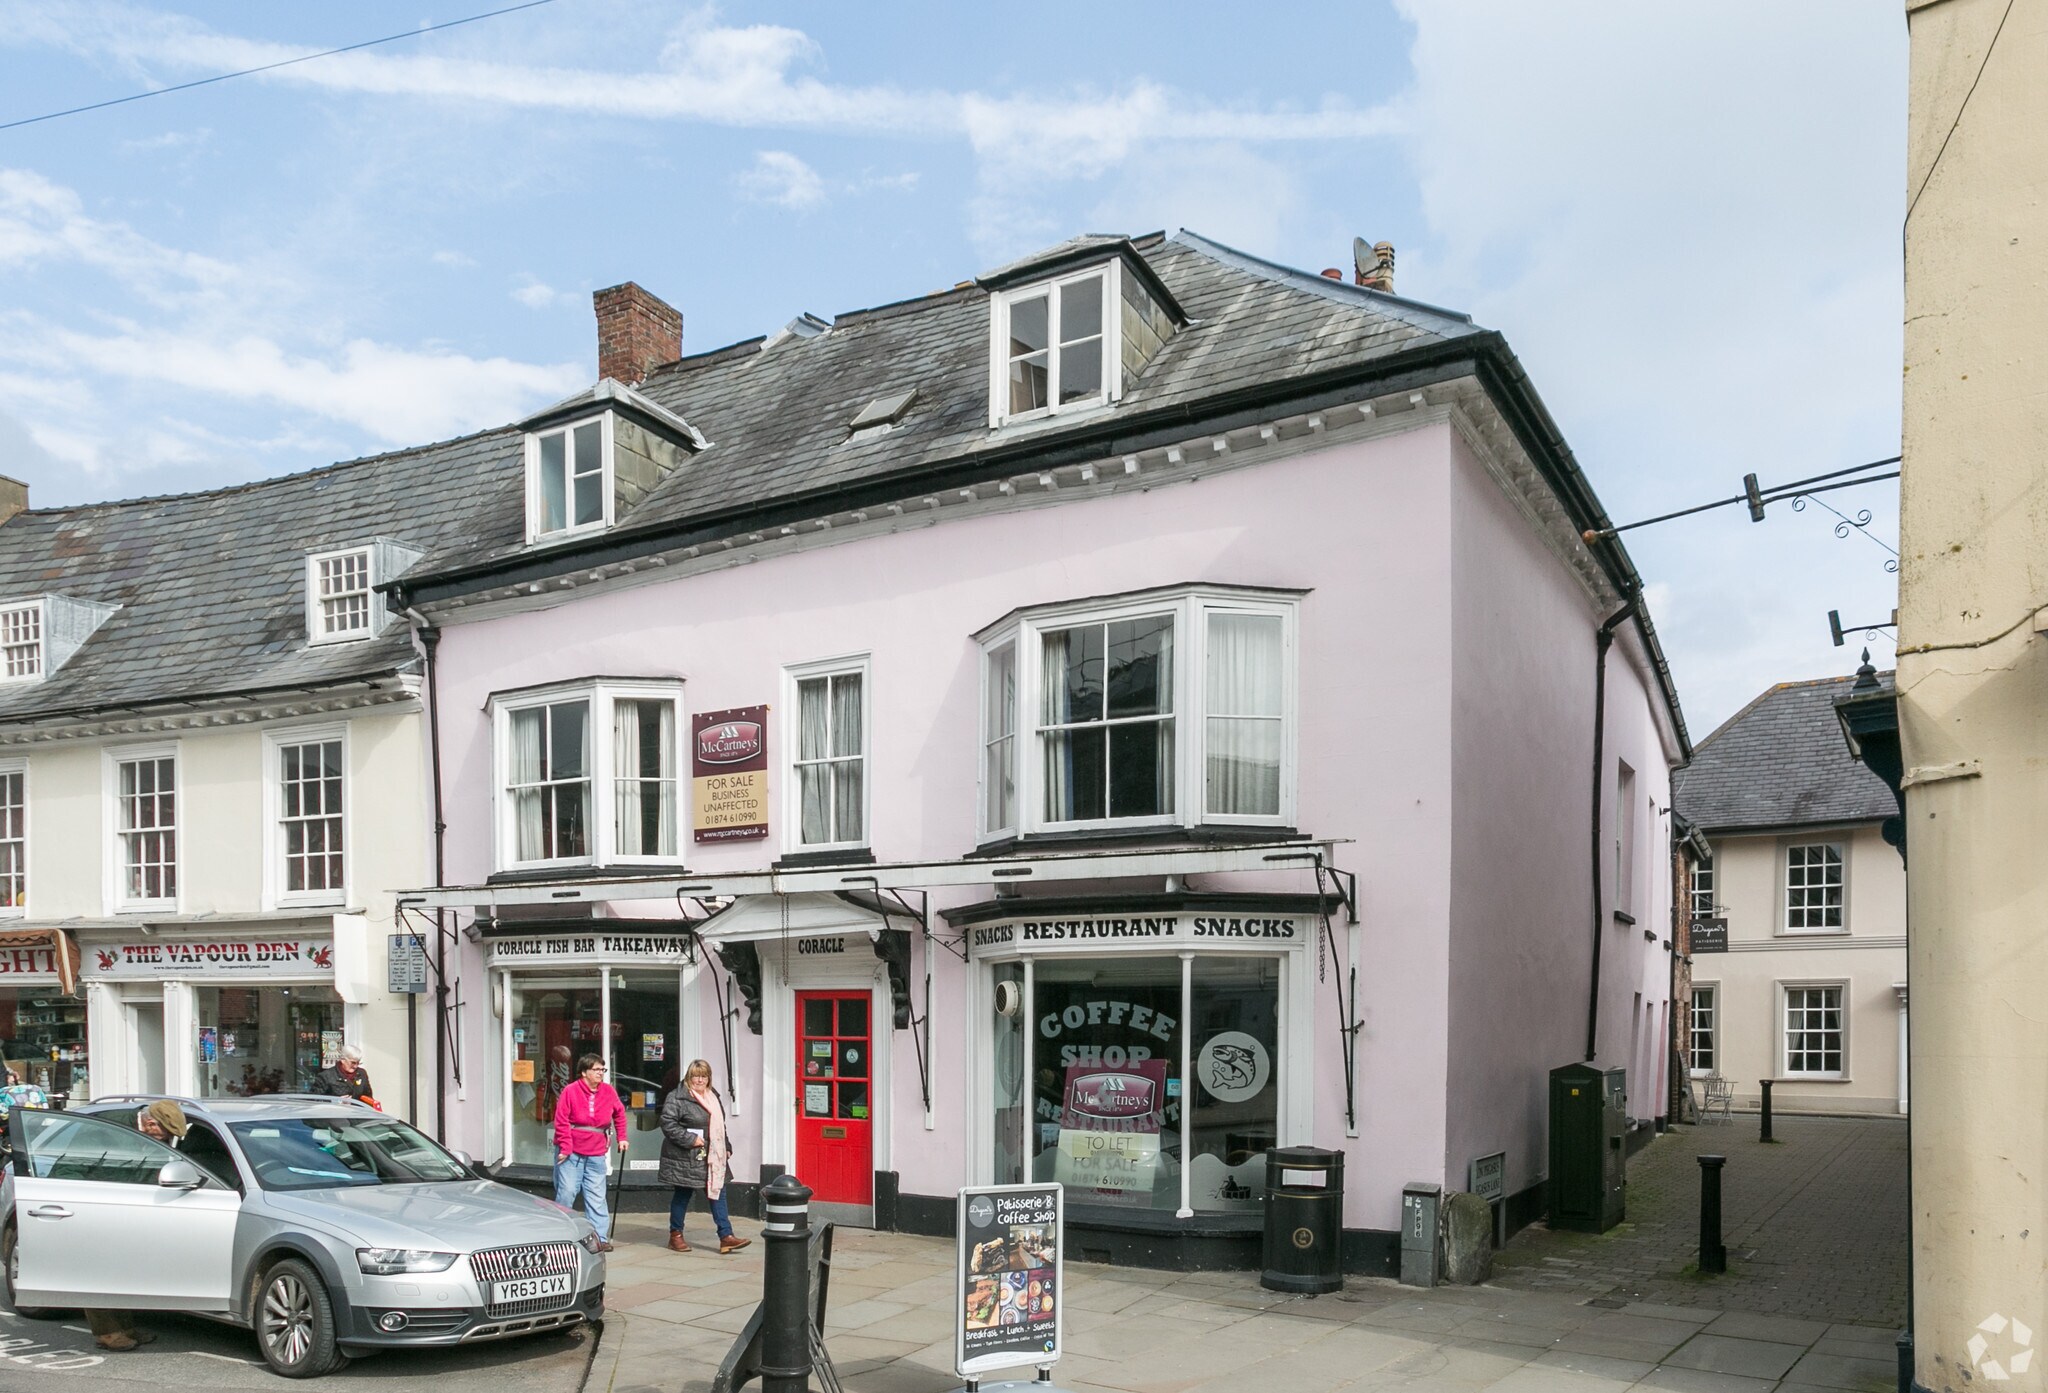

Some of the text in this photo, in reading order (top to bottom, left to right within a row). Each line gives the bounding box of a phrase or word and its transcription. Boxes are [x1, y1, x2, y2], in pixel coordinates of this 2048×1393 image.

[701, 738, 758, 754] McCartneys
[707, 775, 754, 790] FOR SALE
[711, 789, 749, 801] BUSINESS
[703, 799, 758, 813] UNAFFECTED
[705, 812, 757, 825] 01874 610990
[975, 917, 1295, 946] SNACKS RESTAURANT SNACKS
[122, 942, 300, 964] THE VAPOUR DEN
[497, 936, 688, 955] CORACLE FISH BAR TAKEAWAY
[798, 937, 845, 954] CORACLE
[1040, 1001, 1176, 1041] COFFEE
[1061, 1044, 1152, 1069] SHOP
[1075, 1090, 1149, 1110] Mcrtneys
[1036, 1096, 1181, 1135] RESTAURANT
[1085, 1136, 1133, 1150] TO LET
[1072, 1157, 1138, 1173] FOR SALE
[997, 1196, 1042, 1212] Patisserie
[1033, 1211, 1055, 1226] Shop
[501, 1277, 565, 1300] YR63 CVX
[1006, 1326, 1024, 1335] Lunch
